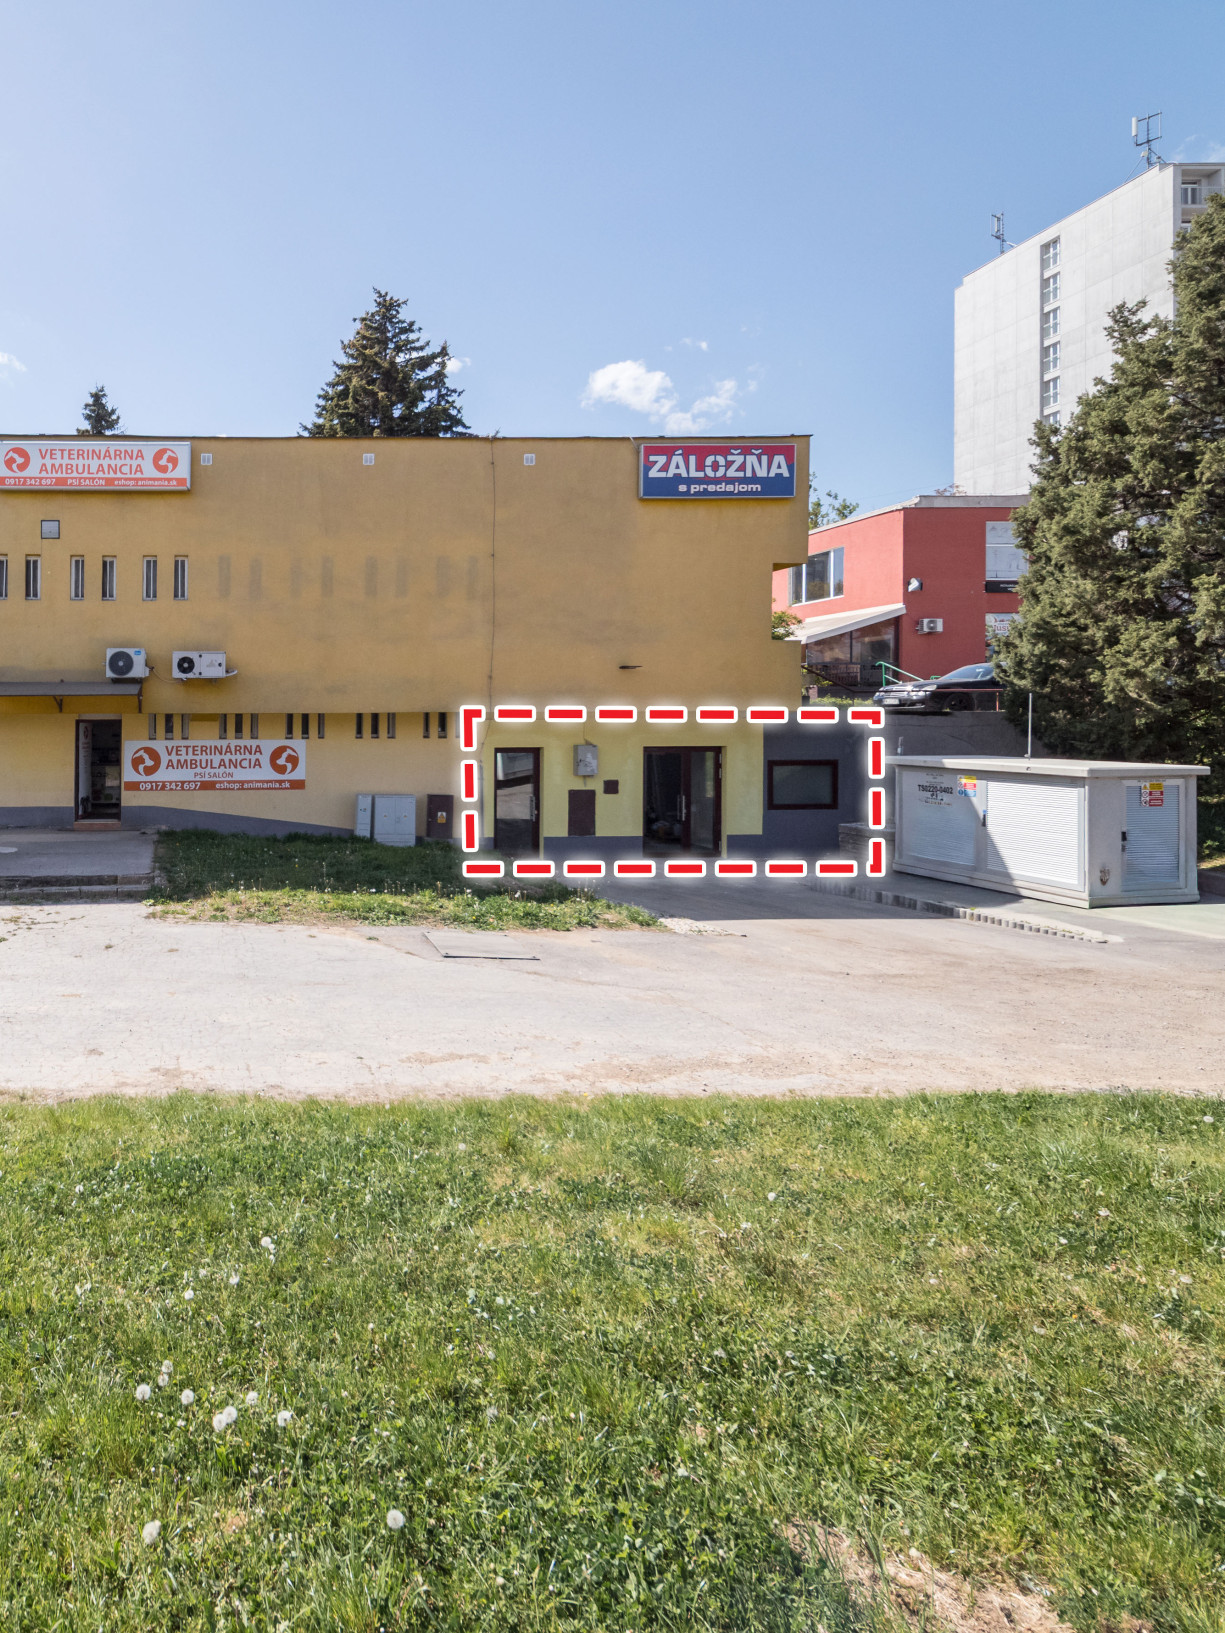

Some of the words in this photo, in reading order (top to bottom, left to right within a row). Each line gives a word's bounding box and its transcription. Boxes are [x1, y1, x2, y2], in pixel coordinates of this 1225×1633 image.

[38, 446, 145, 461] VETERINÁRNA
[648, 447, 790, 478] ZÁLOŽŇA
[38, 463, 144, 475] AMBULANCIA
[67, 478, 79, 486] PSÍ
[80, 478, 105, 486] SALÓN
[678, 484, 687, 492] s
[690, 482, 761, 494] predajom
[165, 742, 263, 756] VETERINÁRNA
[165, 758, 263, 770] AMBULANCIA
[194, 771, 207, 779] PSÍ
[207, 771, 234, 779] SALÓN
[140, 782, 162, 791] 0917
[164, 782, 182, 791] 342
[184, 782, 201, 790] 697
[215, 782, 242, 790] eshop:
[243, 781, 291, 789] animania.sk
